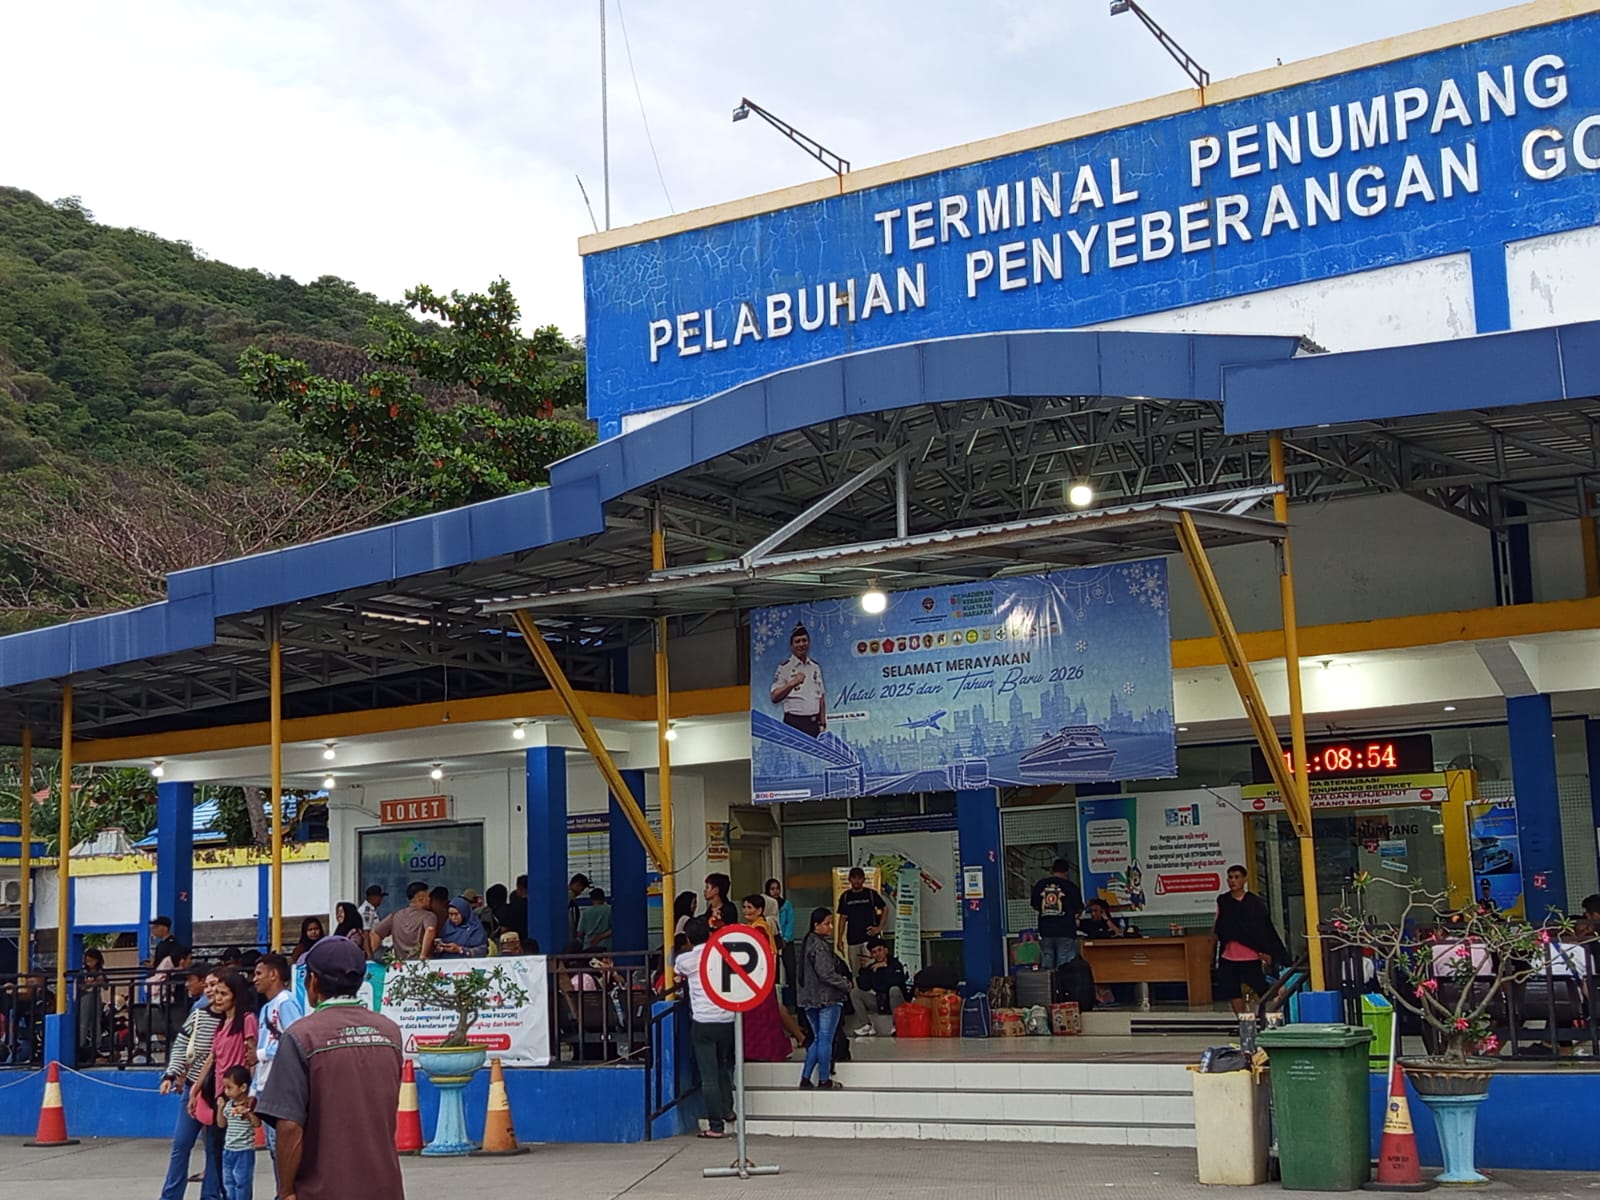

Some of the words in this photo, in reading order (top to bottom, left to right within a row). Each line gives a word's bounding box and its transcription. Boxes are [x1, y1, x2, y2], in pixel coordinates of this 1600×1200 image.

[874, 156, 1139, 256] TERMINAL
[1189, 53, 1568, 188] PENUMPANG
[648, 263, 927, 363] PELABUHAN
[965, 142, 1480, 299] PENYEBERANGAN
[882, 661, 943, 679] SELAMAT
[945, 651, 1031, 672] MERAYAKAN
[833, 682, 876, 709] Natal
[880, 682, 916, 699] 2025
[916, 683, 943, 695] dan
[946, 669, 996, 700] Tahun
[998, 665, 1044, 695] Baru
[1049, 664, 1085, 683] 2026
[1310, 784, 1365, 795] ENUMPANG
[1366, 782, 1412, 791] BERTIKET
[1324, 777, 1380, 787] STERILISASI
[1329, 792, 1349, 800] DAN
[1351, 789, 1409, 799] PENJEMPUT
[386, 801, 440, 821] LOKET
[409, 851, 447, 872] asdp
